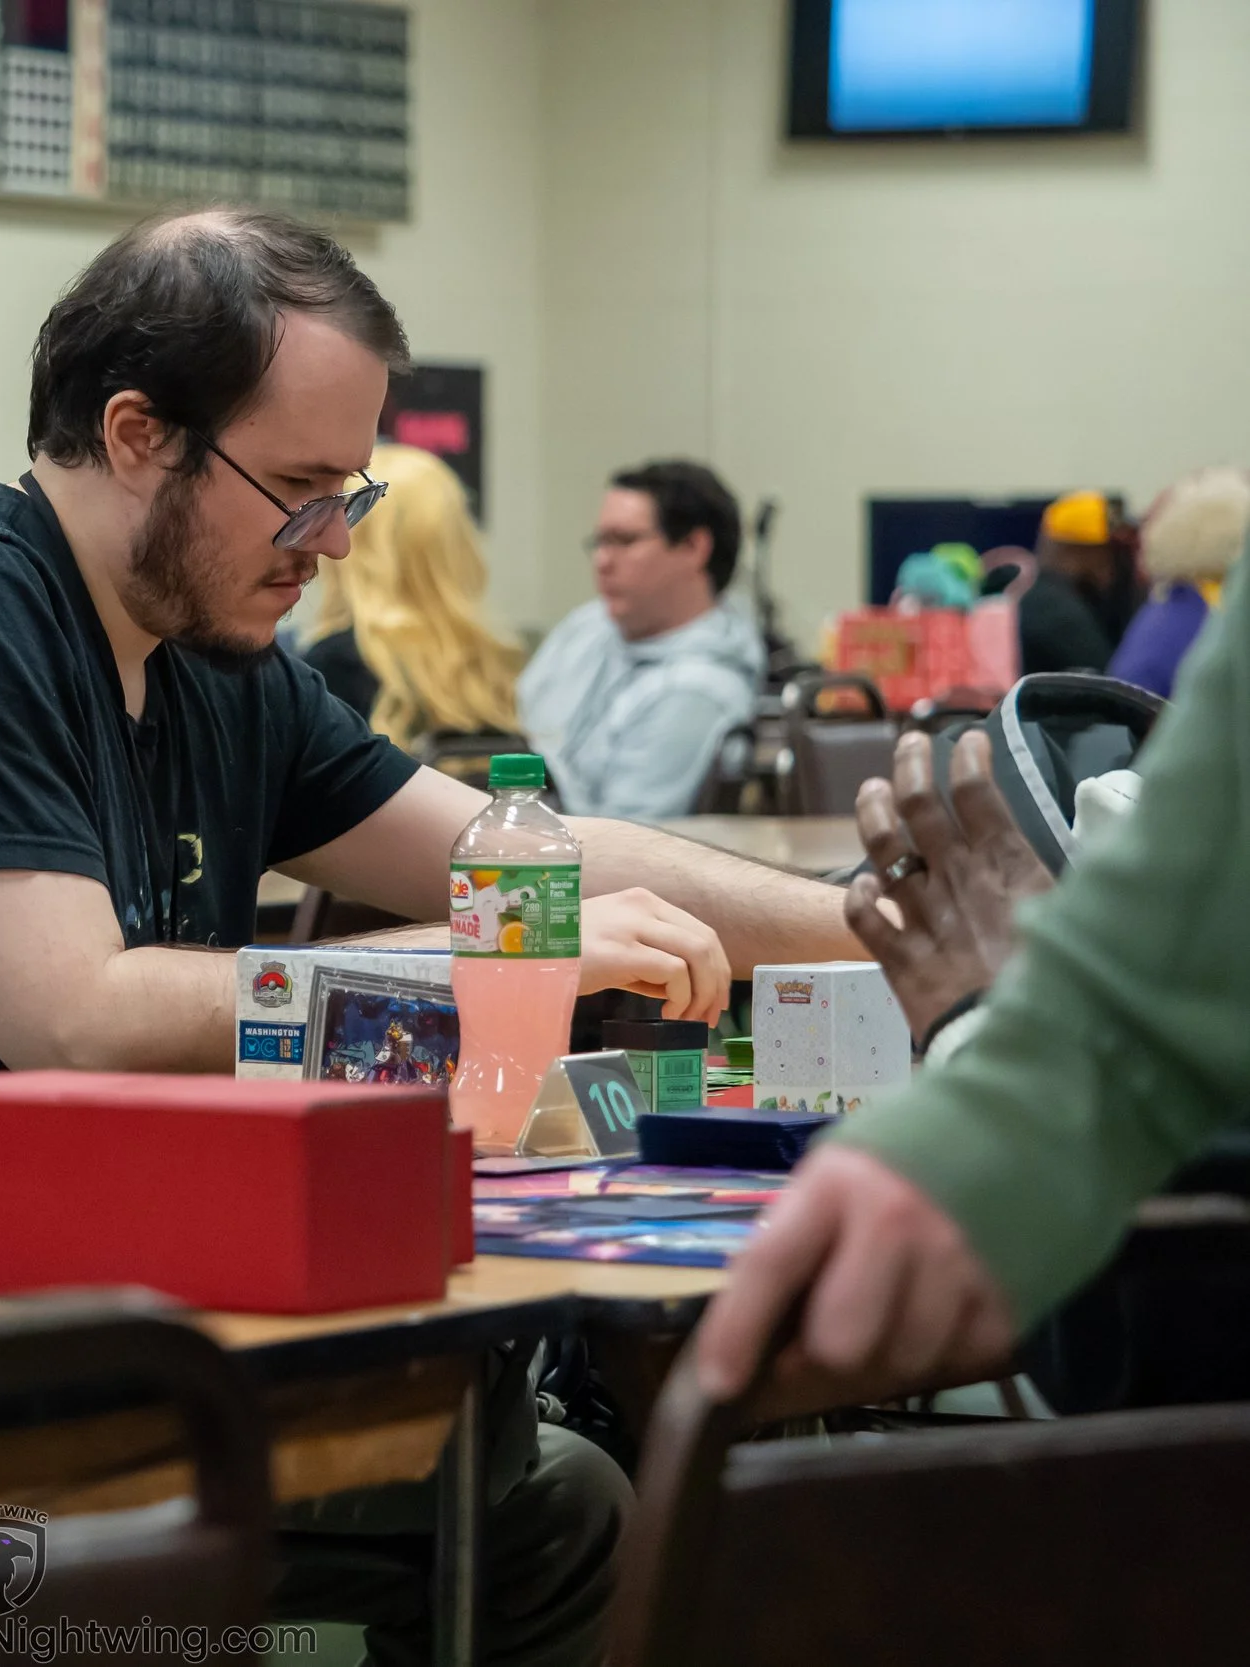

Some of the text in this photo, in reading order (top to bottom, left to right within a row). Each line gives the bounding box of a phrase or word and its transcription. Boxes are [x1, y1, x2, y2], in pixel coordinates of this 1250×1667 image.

[451, 919, 481, 939] NADE
[244, 1027, 301, 1038] WASHINGTON
[244, 1036, 277, 1058] DC
[588, 1079, 637, 1133] 10
